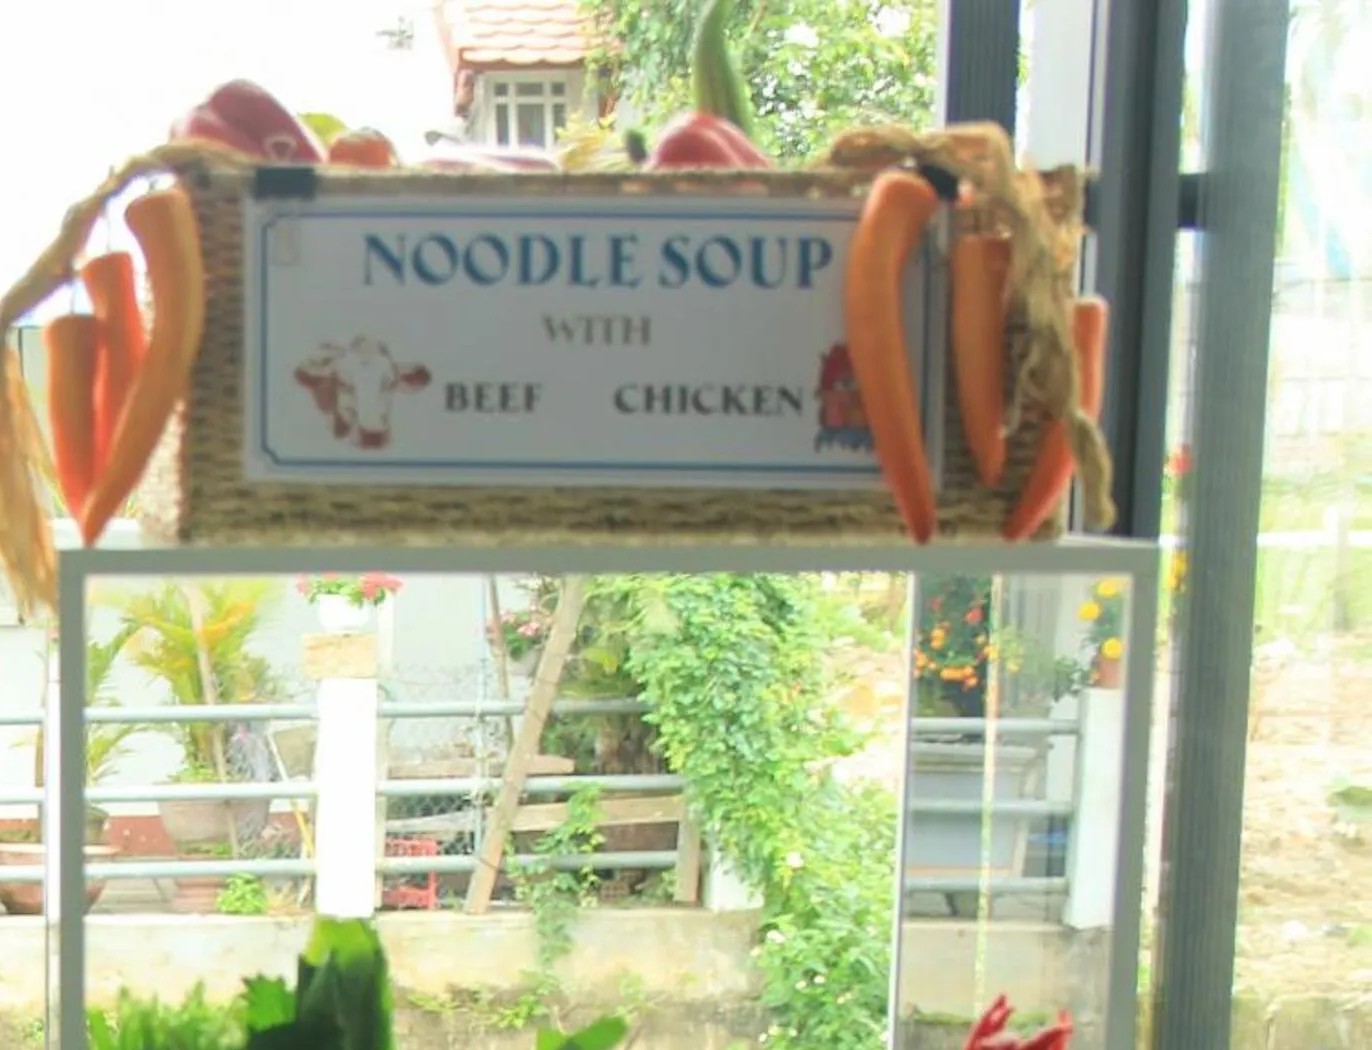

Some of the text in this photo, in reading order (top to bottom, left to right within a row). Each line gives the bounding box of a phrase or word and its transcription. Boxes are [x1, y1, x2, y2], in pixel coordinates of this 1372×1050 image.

[363, 232, 833, 290] NOODLE SOUP
[541, 314, 652, 346] WITH
[444, 382, 542, 413] BEEF
[613, 383, 803, 417] CHICKEN
